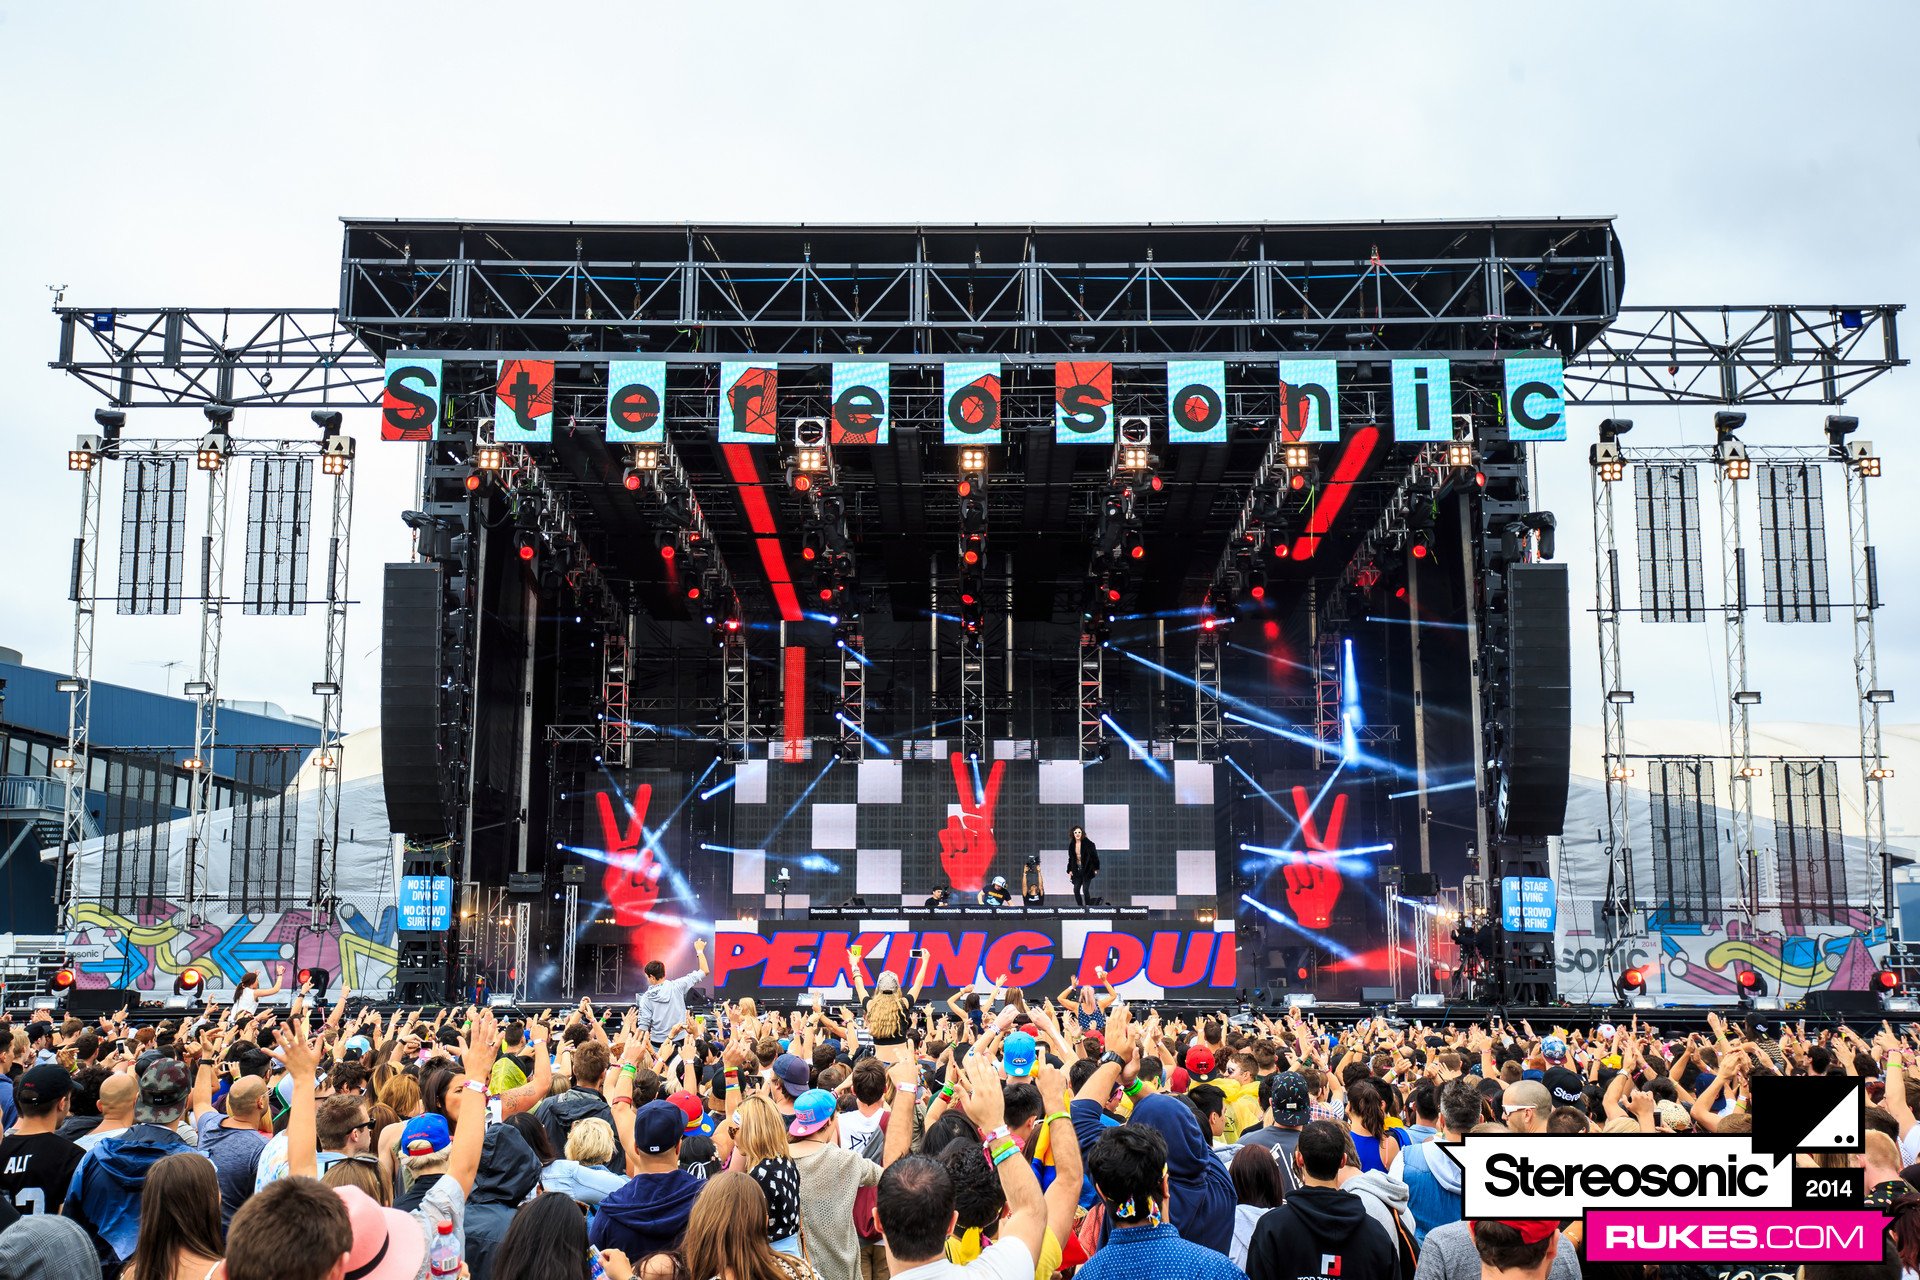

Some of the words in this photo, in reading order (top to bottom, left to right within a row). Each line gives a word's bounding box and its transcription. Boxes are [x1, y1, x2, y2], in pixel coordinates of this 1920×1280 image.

[407, 880, 419, 890] NO
[1524, 881, 1549, 892] STAGE
[403, 906, 415, 916] NO
[416, 906, 447, 916] CROWD
[1508, 906, 1521, 917] NO
[1522, 907, 1552, 918] CROWD
[1513, 917, 1548, 929] SRFING
[714, 931, 1056, 989] PEKING
